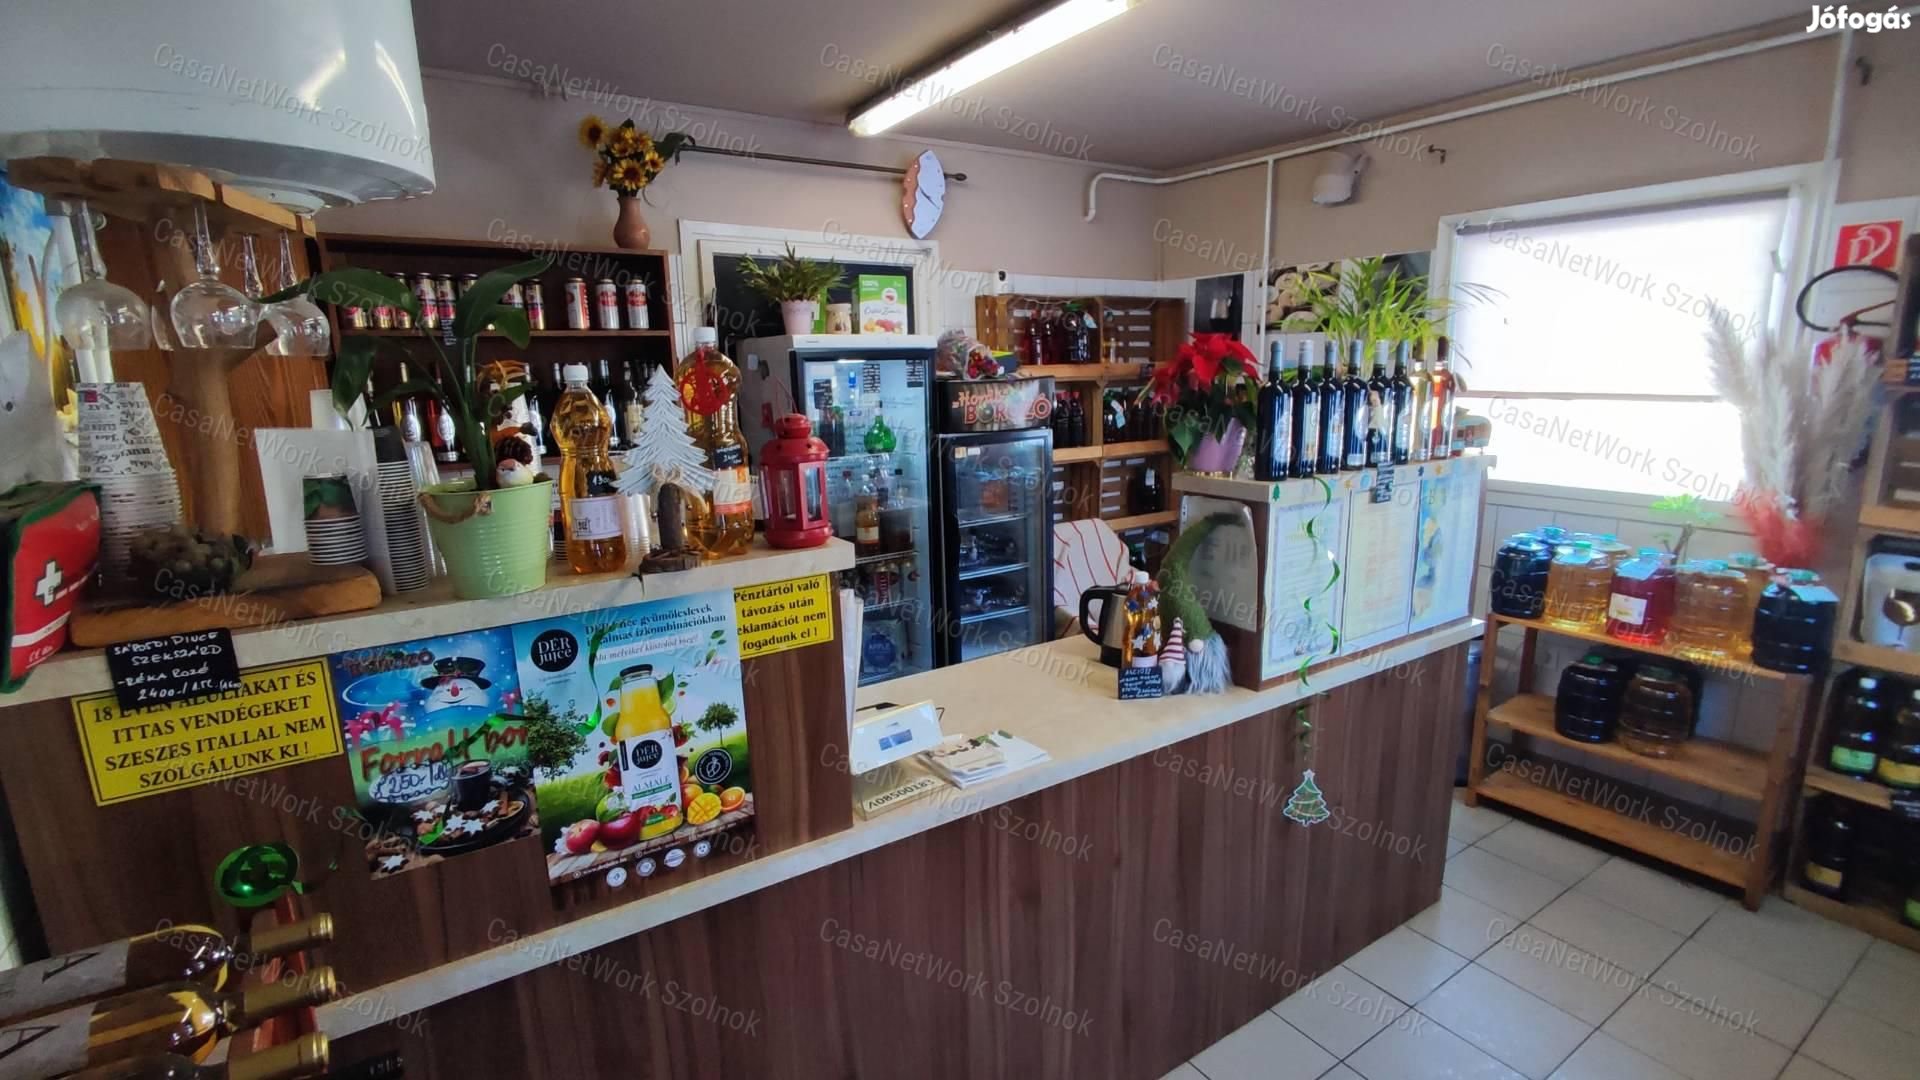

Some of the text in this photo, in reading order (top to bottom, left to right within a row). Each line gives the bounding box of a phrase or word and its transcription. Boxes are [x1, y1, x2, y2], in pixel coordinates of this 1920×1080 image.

[734, 578, 820, 602] Pénztártól való
[742, 597, 814, 618] távozás után
[737, 611, 827, 635] eklamációt nem
[538, 638, 571, 653] DER
[743, 631, 797, 651] fogadunk
[800, 628, 810, 639] el
[131, 644, 222, 666] SZEKSZÁRD
[539, 649, 572, 666] juice
[93, 705, 113, 724] 18
[296, 669, 317, 688] ÉS
[113, 694, 312, 745] ITTAS VENDÉGEKET
[105, 715, 327, 771] SZESZES ITALLAL NEM
[139, 750, 276, 789] SZOLGÁLUNK
[280, 744, 299, 760] KI
